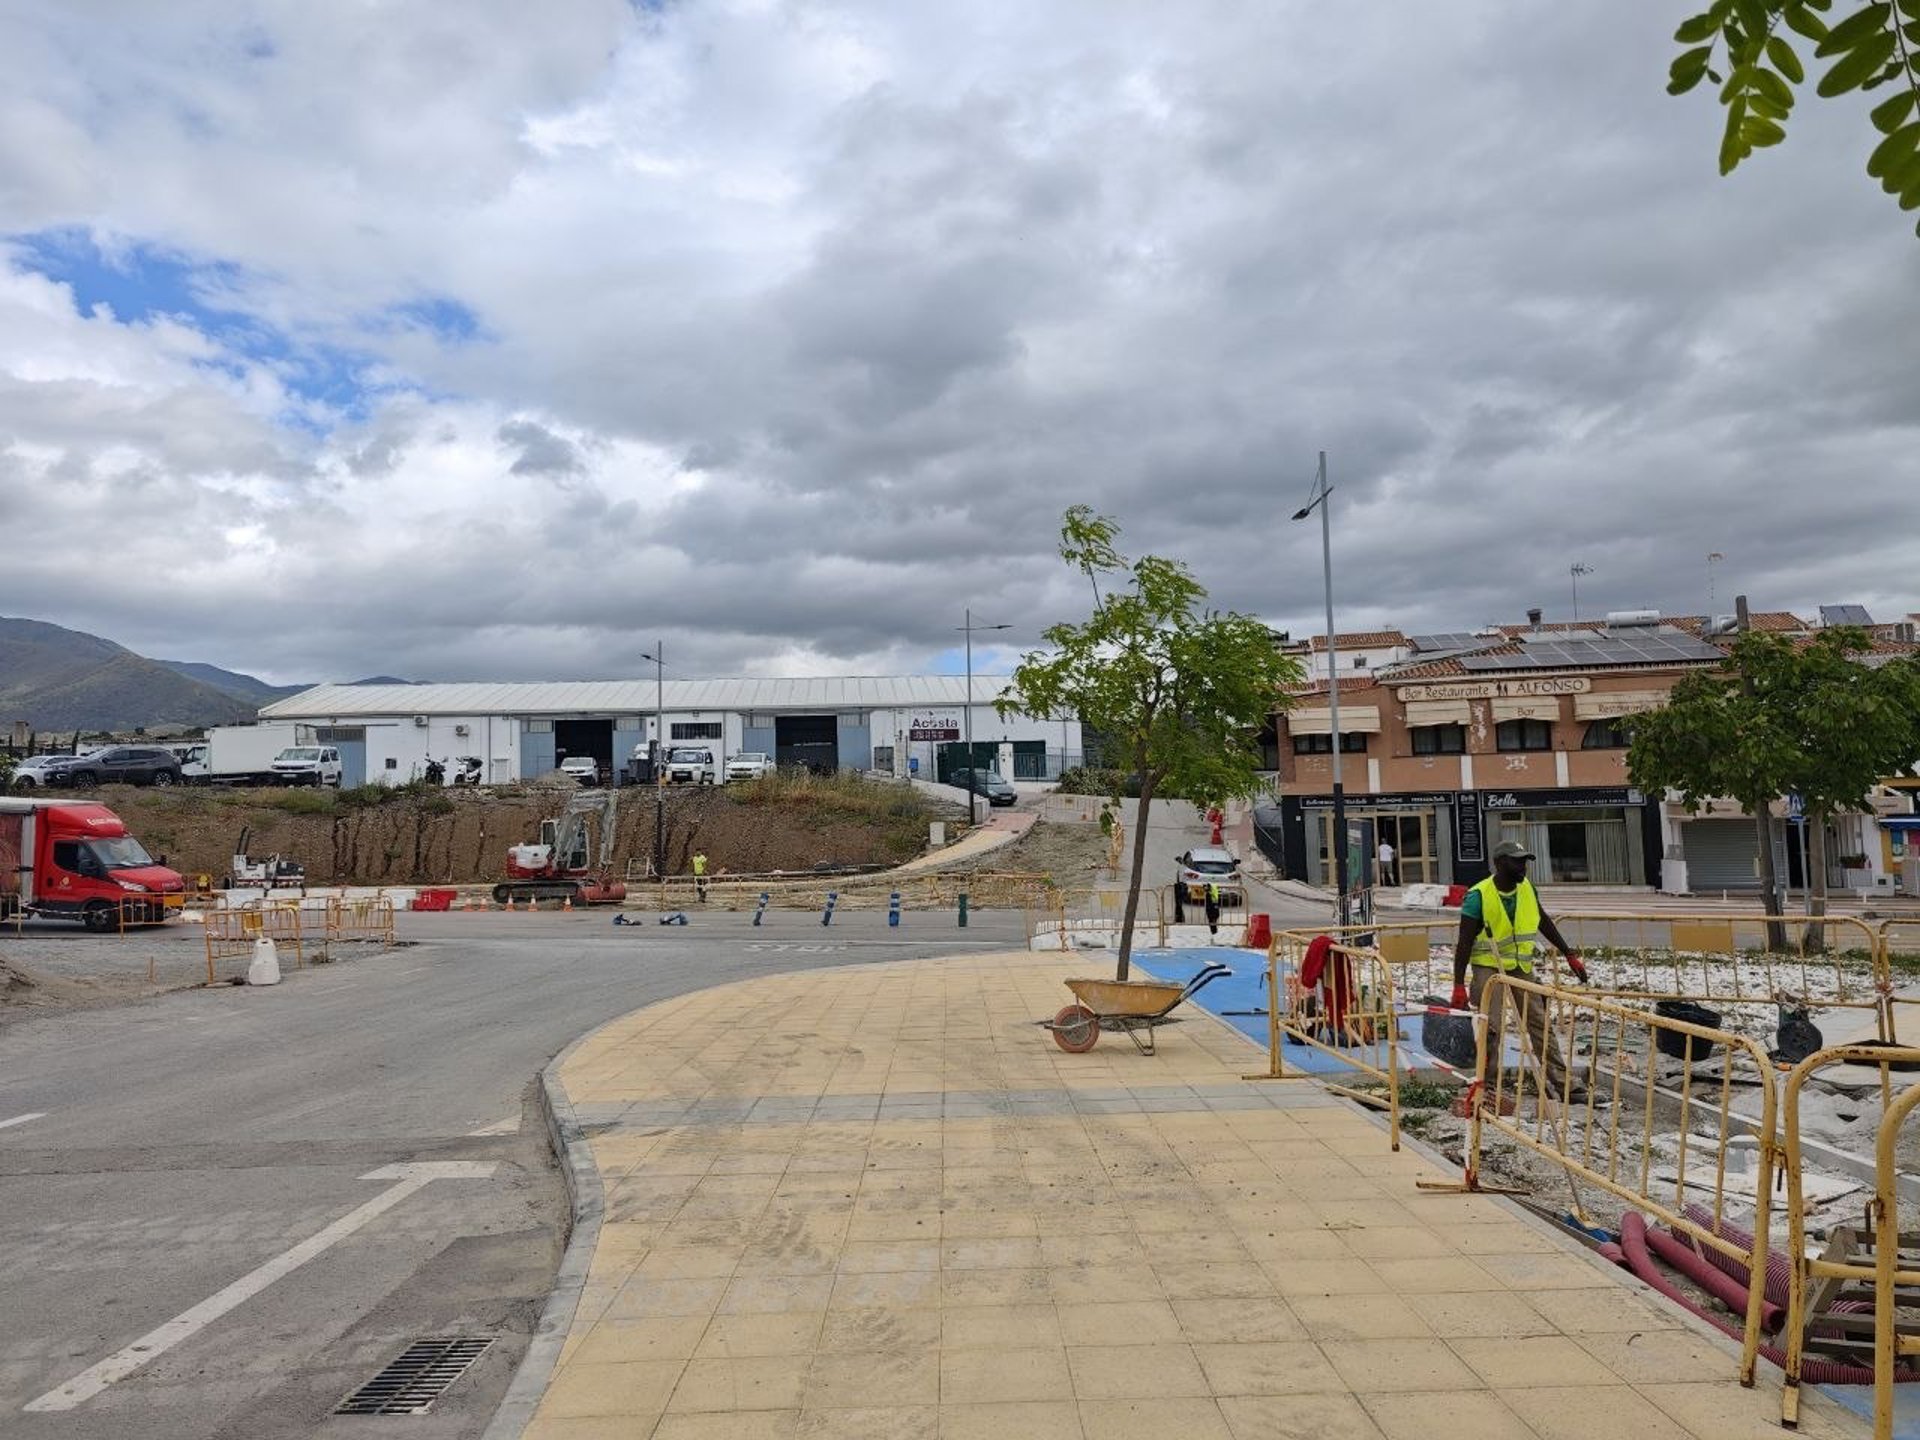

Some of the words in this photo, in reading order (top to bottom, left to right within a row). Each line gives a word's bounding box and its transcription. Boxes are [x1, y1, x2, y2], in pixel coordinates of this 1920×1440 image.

[1405, 688, 1422, 699] Bar
[1425, 684, 1489, 698] Restaurante
[1516, 679, 1585, 694] ALFONSO
[1517, 707, 1535, 716] Bar
[1487, 793, 1517, 807] Bella
